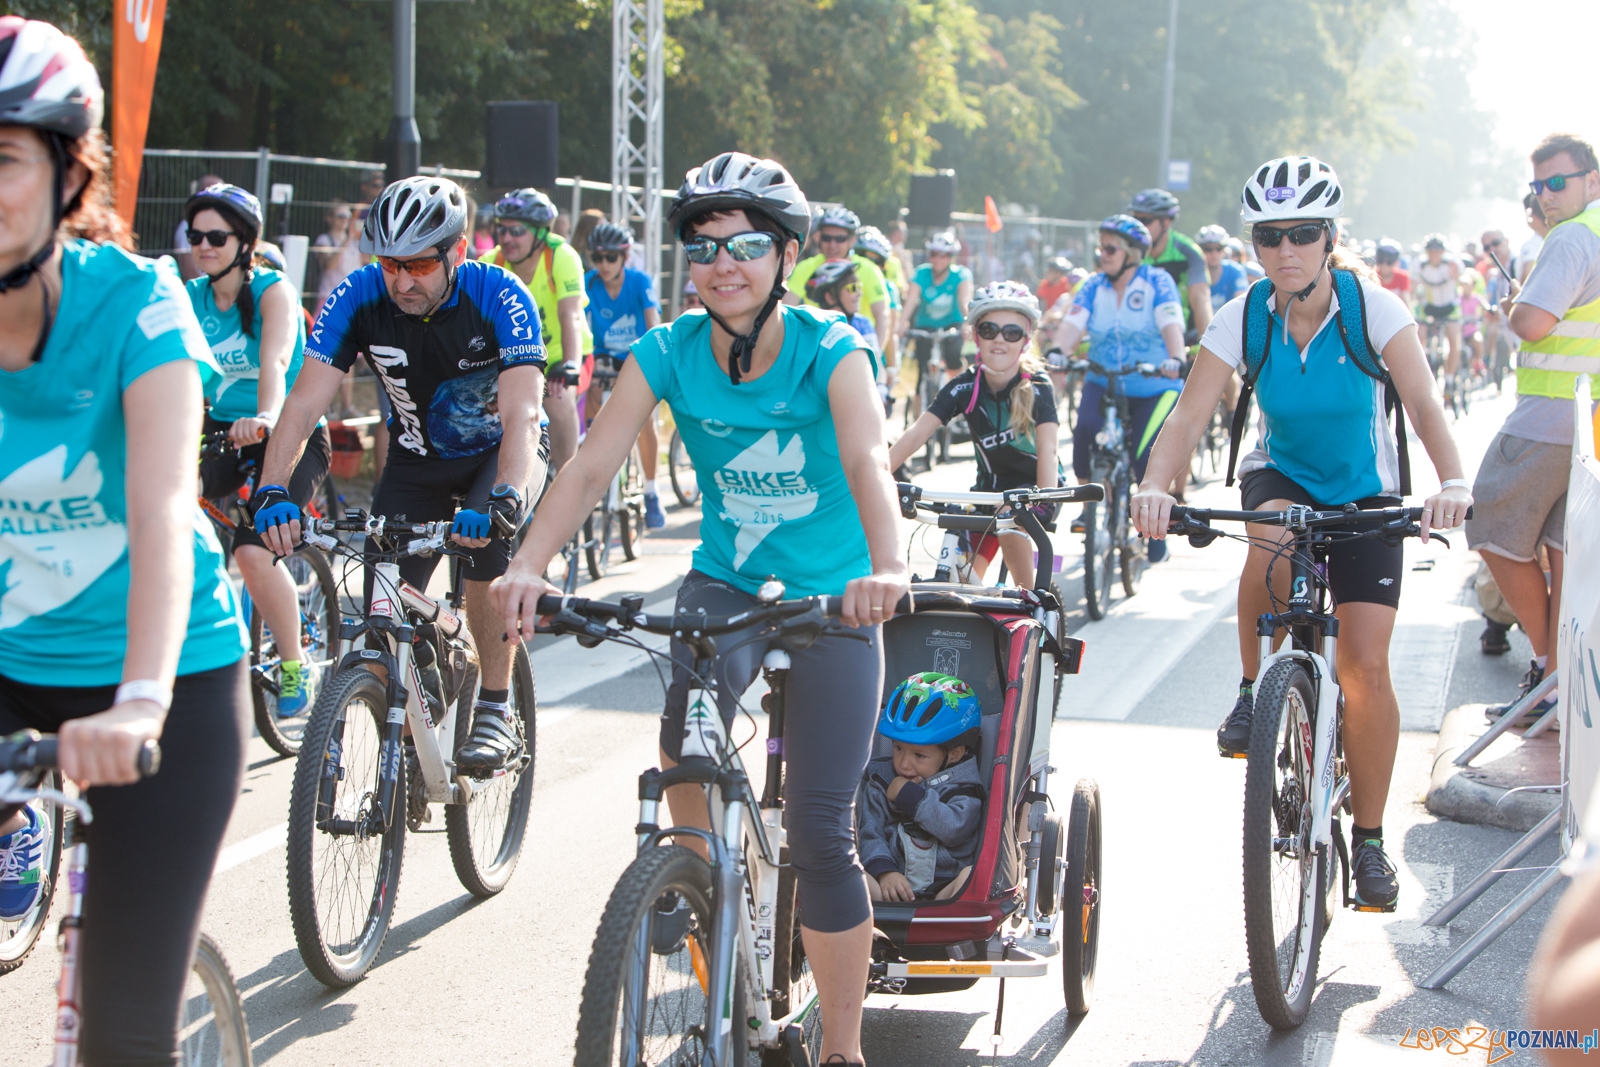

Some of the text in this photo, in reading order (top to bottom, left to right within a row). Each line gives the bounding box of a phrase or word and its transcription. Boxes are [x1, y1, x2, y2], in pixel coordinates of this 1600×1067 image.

[498, 287, 530, 327] AMD
[718, 467, 800, 489] BIKE
[0, 496, 95, 520] IKE
[753, 510, 785, 525] 2016
[1378, 577, 1394, 587] 4F
[390, 739, 402, 782] FOX
